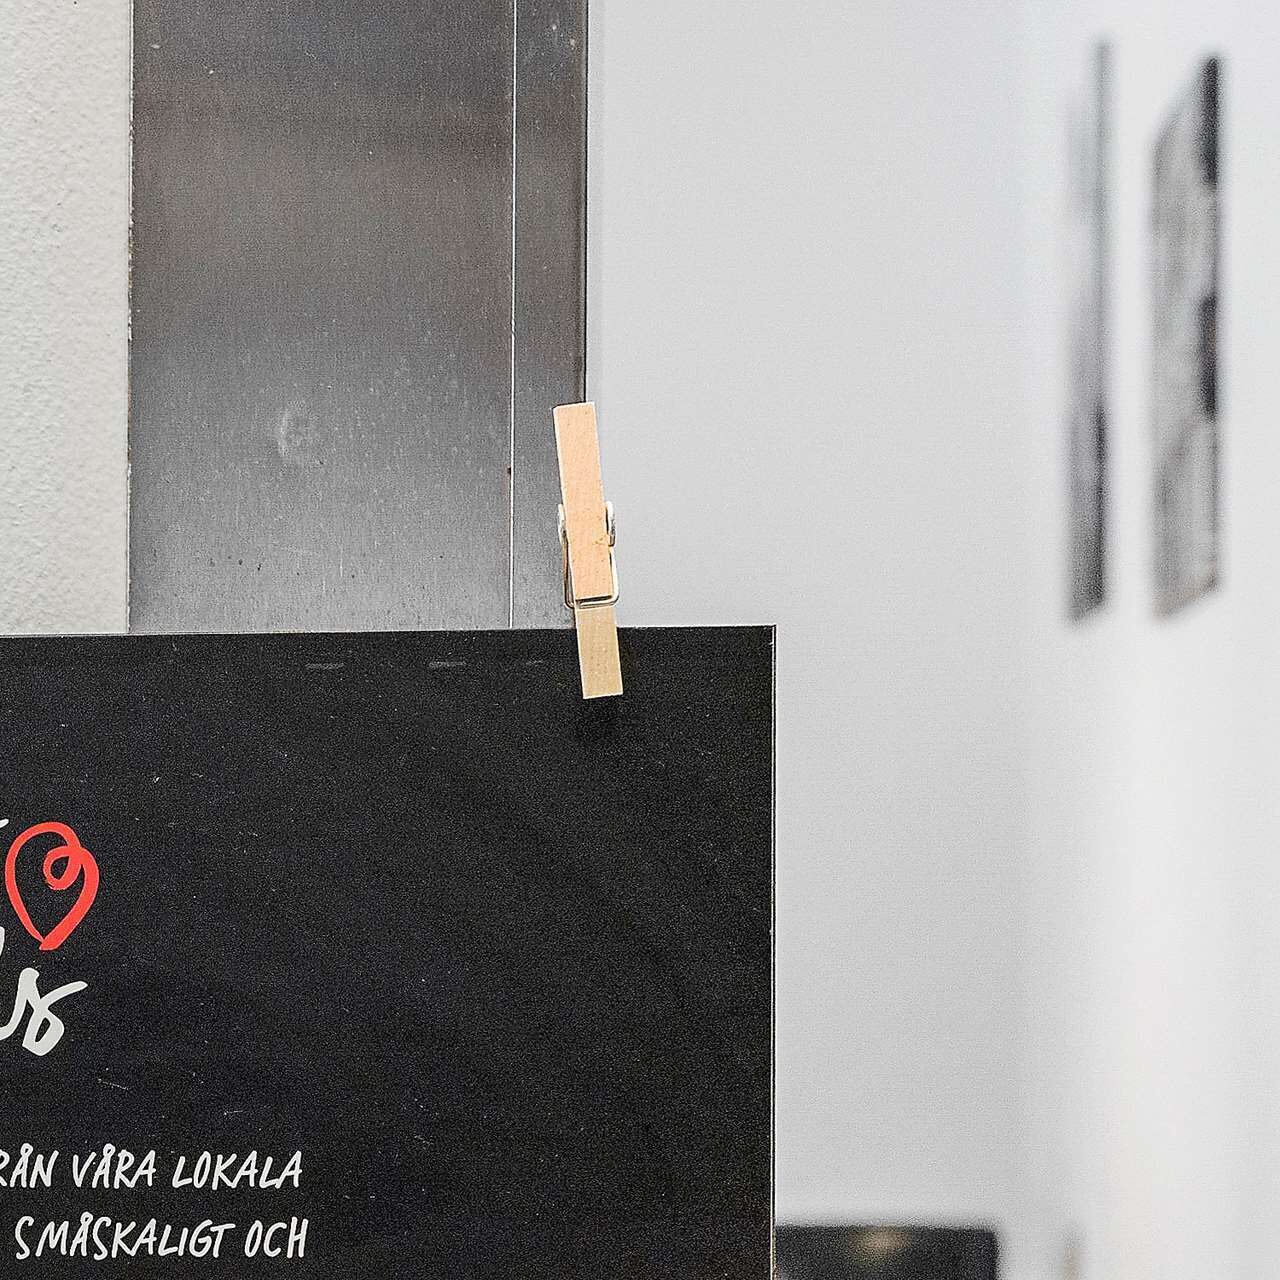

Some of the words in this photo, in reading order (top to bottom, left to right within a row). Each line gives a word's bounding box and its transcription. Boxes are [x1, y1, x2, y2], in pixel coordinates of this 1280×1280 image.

[73, 1144, 156, 1189] VÅRA
[172, 1151, 302, 1190] LOKALA
[15, 1212, 235, 1260] SMÅSKALIGT
[245, 1217, 308, 1258] OCH
